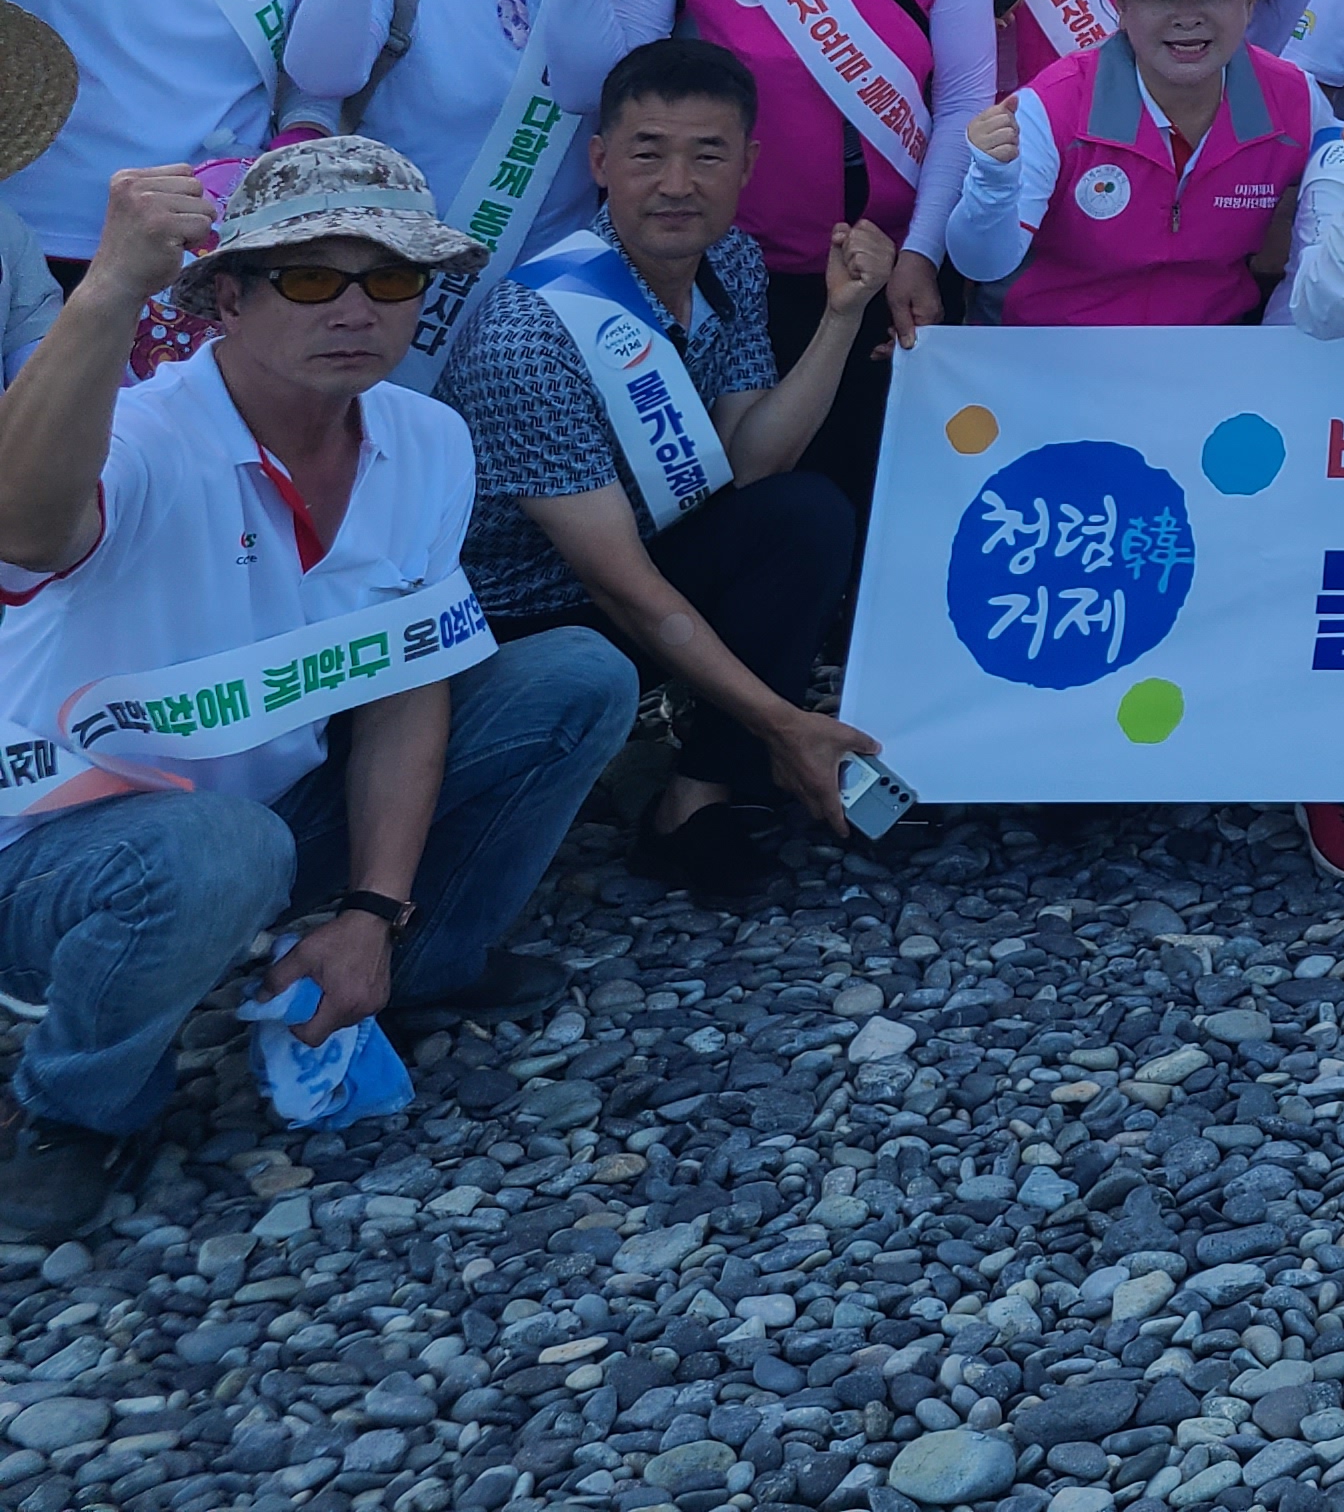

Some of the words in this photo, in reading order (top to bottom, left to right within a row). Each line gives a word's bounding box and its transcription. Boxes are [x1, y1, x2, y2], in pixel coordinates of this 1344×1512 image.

[489, 95, 563, 199] 다함께
[411, 199, 514, 356] 동합시다
[987, 586, 1128, 665] 거제
[262, 632, 391, 713] 다함께
